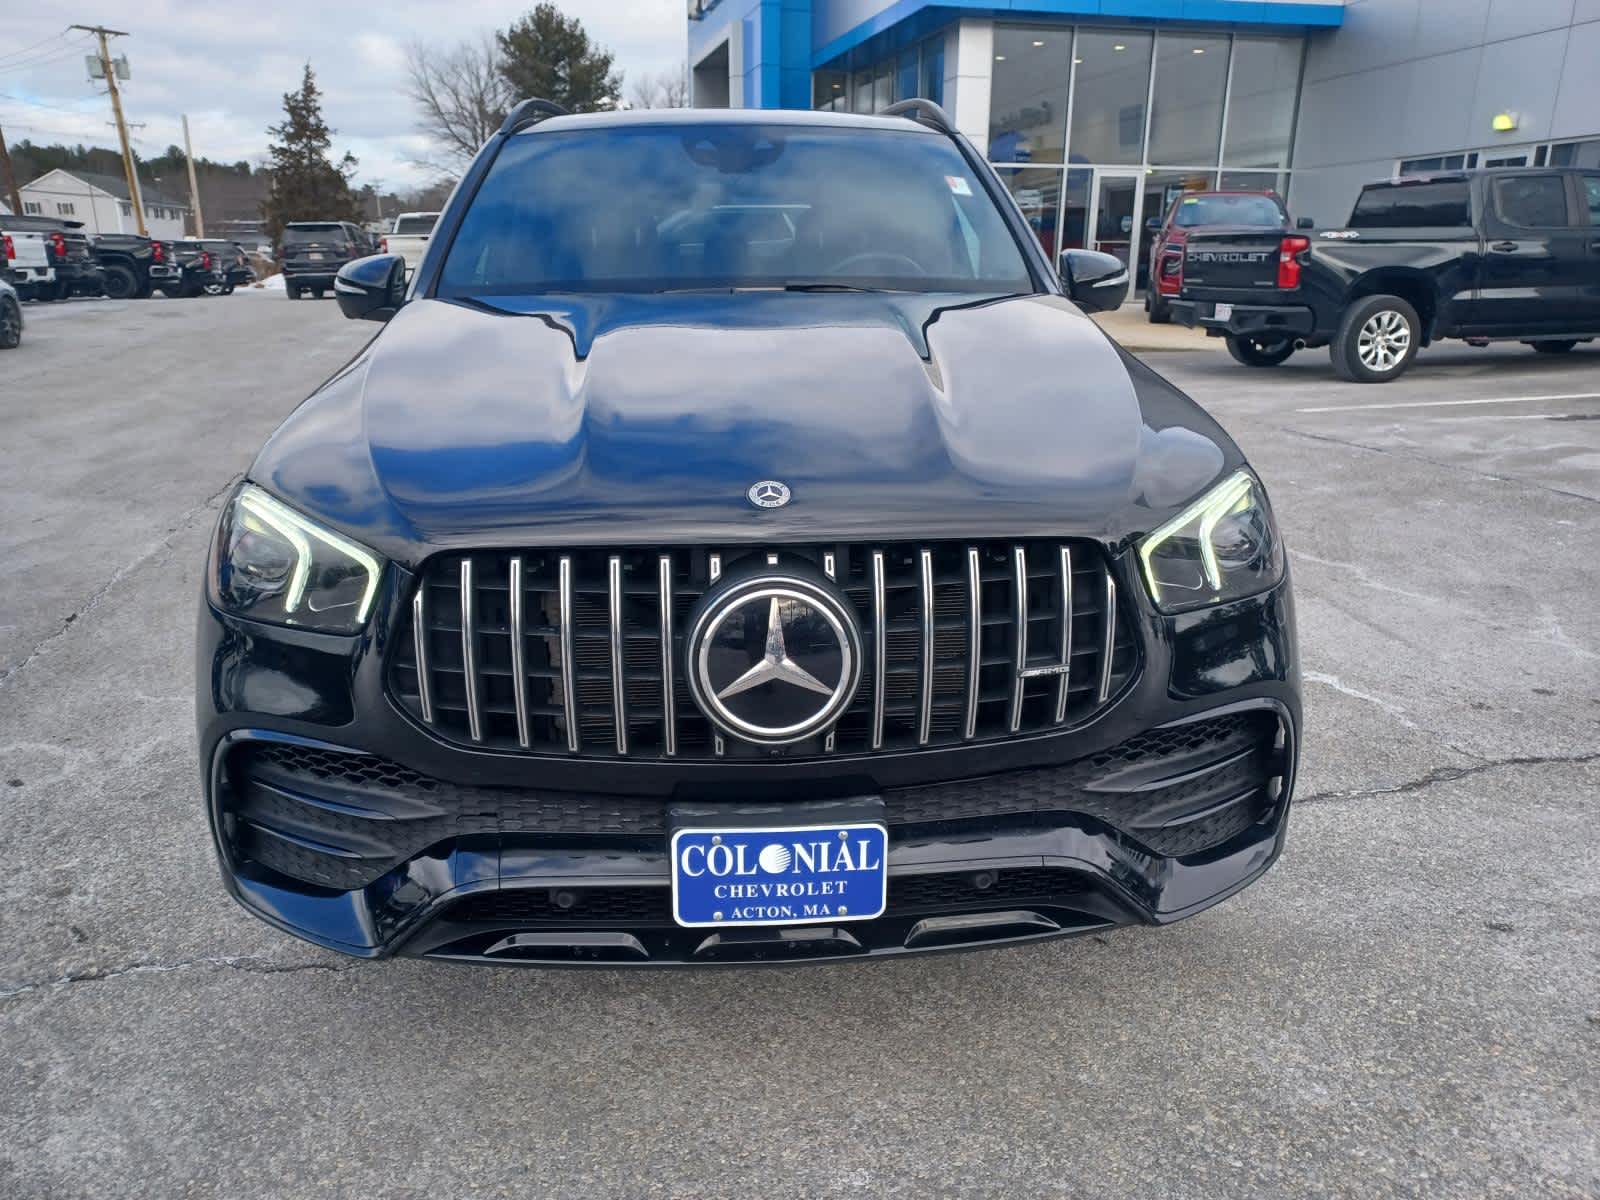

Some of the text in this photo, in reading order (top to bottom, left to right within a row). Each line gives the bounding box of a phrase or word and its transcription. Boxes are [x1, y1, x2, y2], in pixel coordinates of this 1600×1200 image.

[1187, 252, 1270, 263] CHEVROLET
[714, 880, 848, 899] CHEVROLET
[731, 904, 831, 920] ACTON, MA
